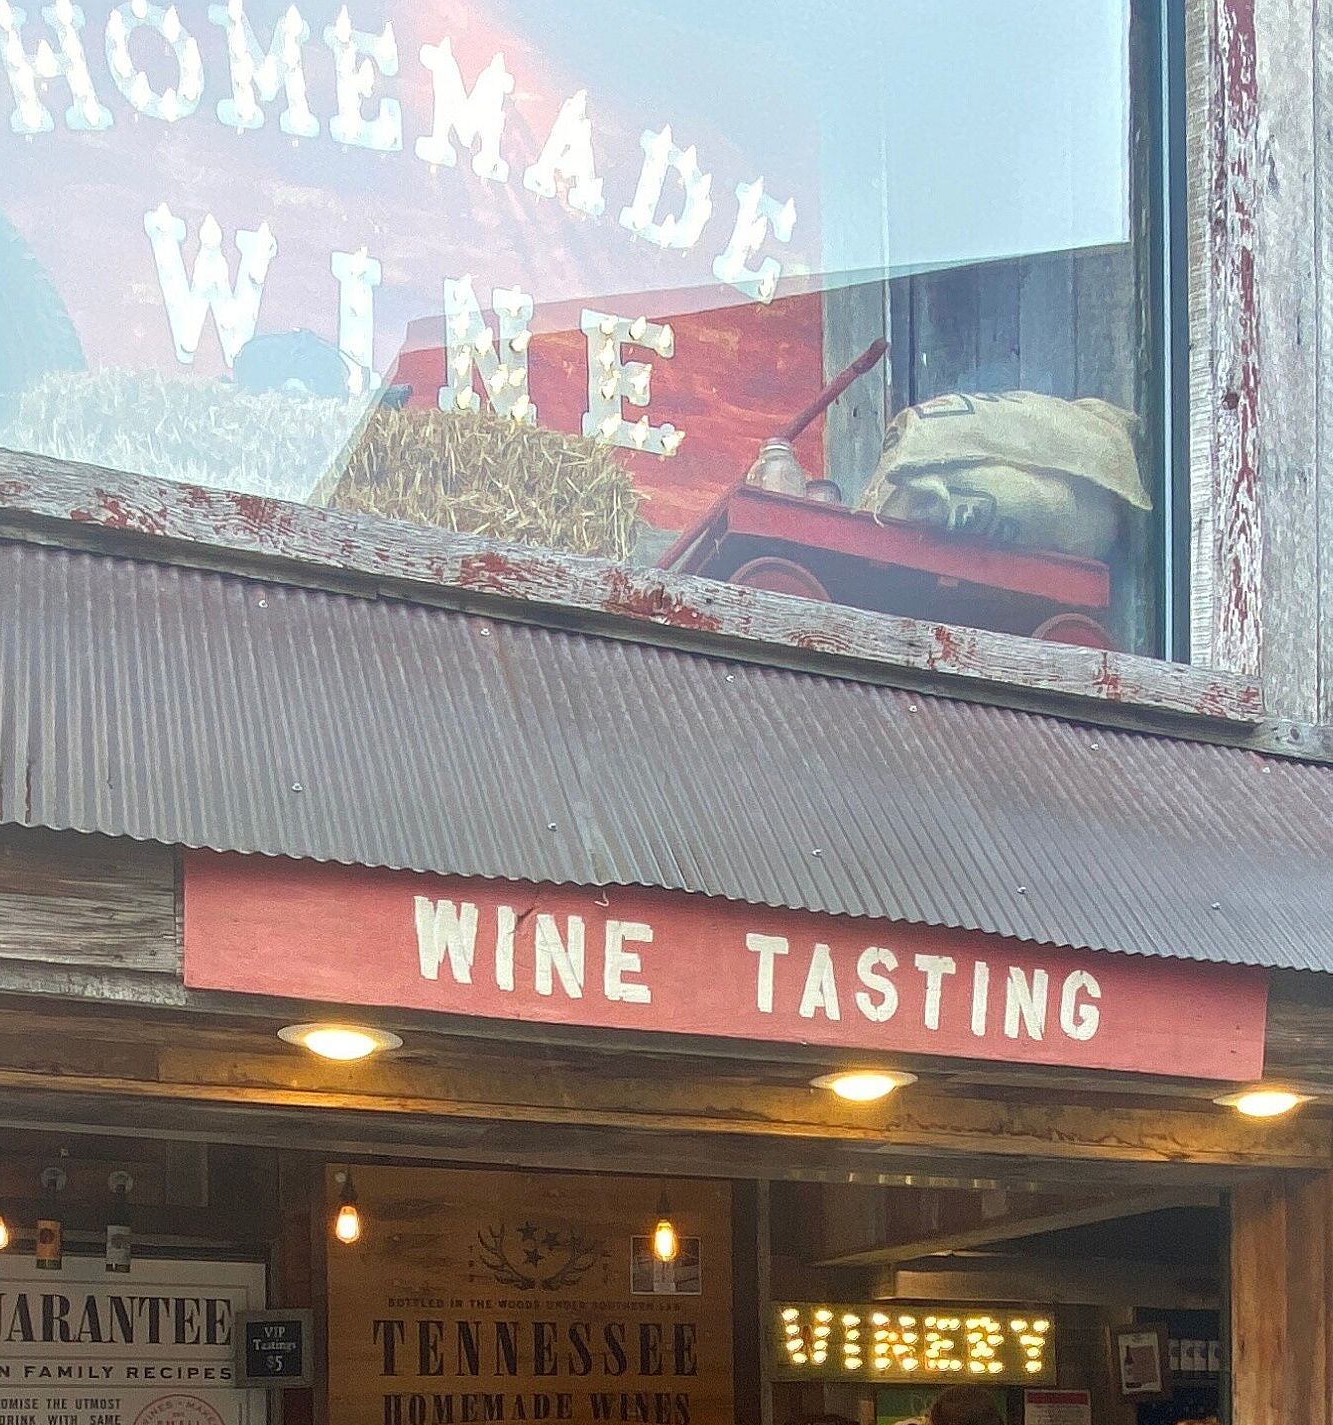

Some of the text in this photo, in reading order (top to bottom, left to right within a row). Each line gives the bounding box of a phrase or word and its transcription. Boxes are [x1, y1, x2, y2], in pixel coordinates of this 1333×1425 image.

[143, 202, 686, 456] WINE
[412, 895, 1105, 1042] WINE TASTING
[263, 1326, 285, 1338] VIP
[373, 1319, 698, 1377] TENNESSEE
[24, 1366, 114, 1380] FAMILY
[126, 1367, 232, 1380] RECIPES
[46, 1398, 68, 1410] THE
[75, 1398, 121, 1410] UTMOST
[47, 1415, 78, 1425] WITH
[90, 1415, 121, 1425] SAME
